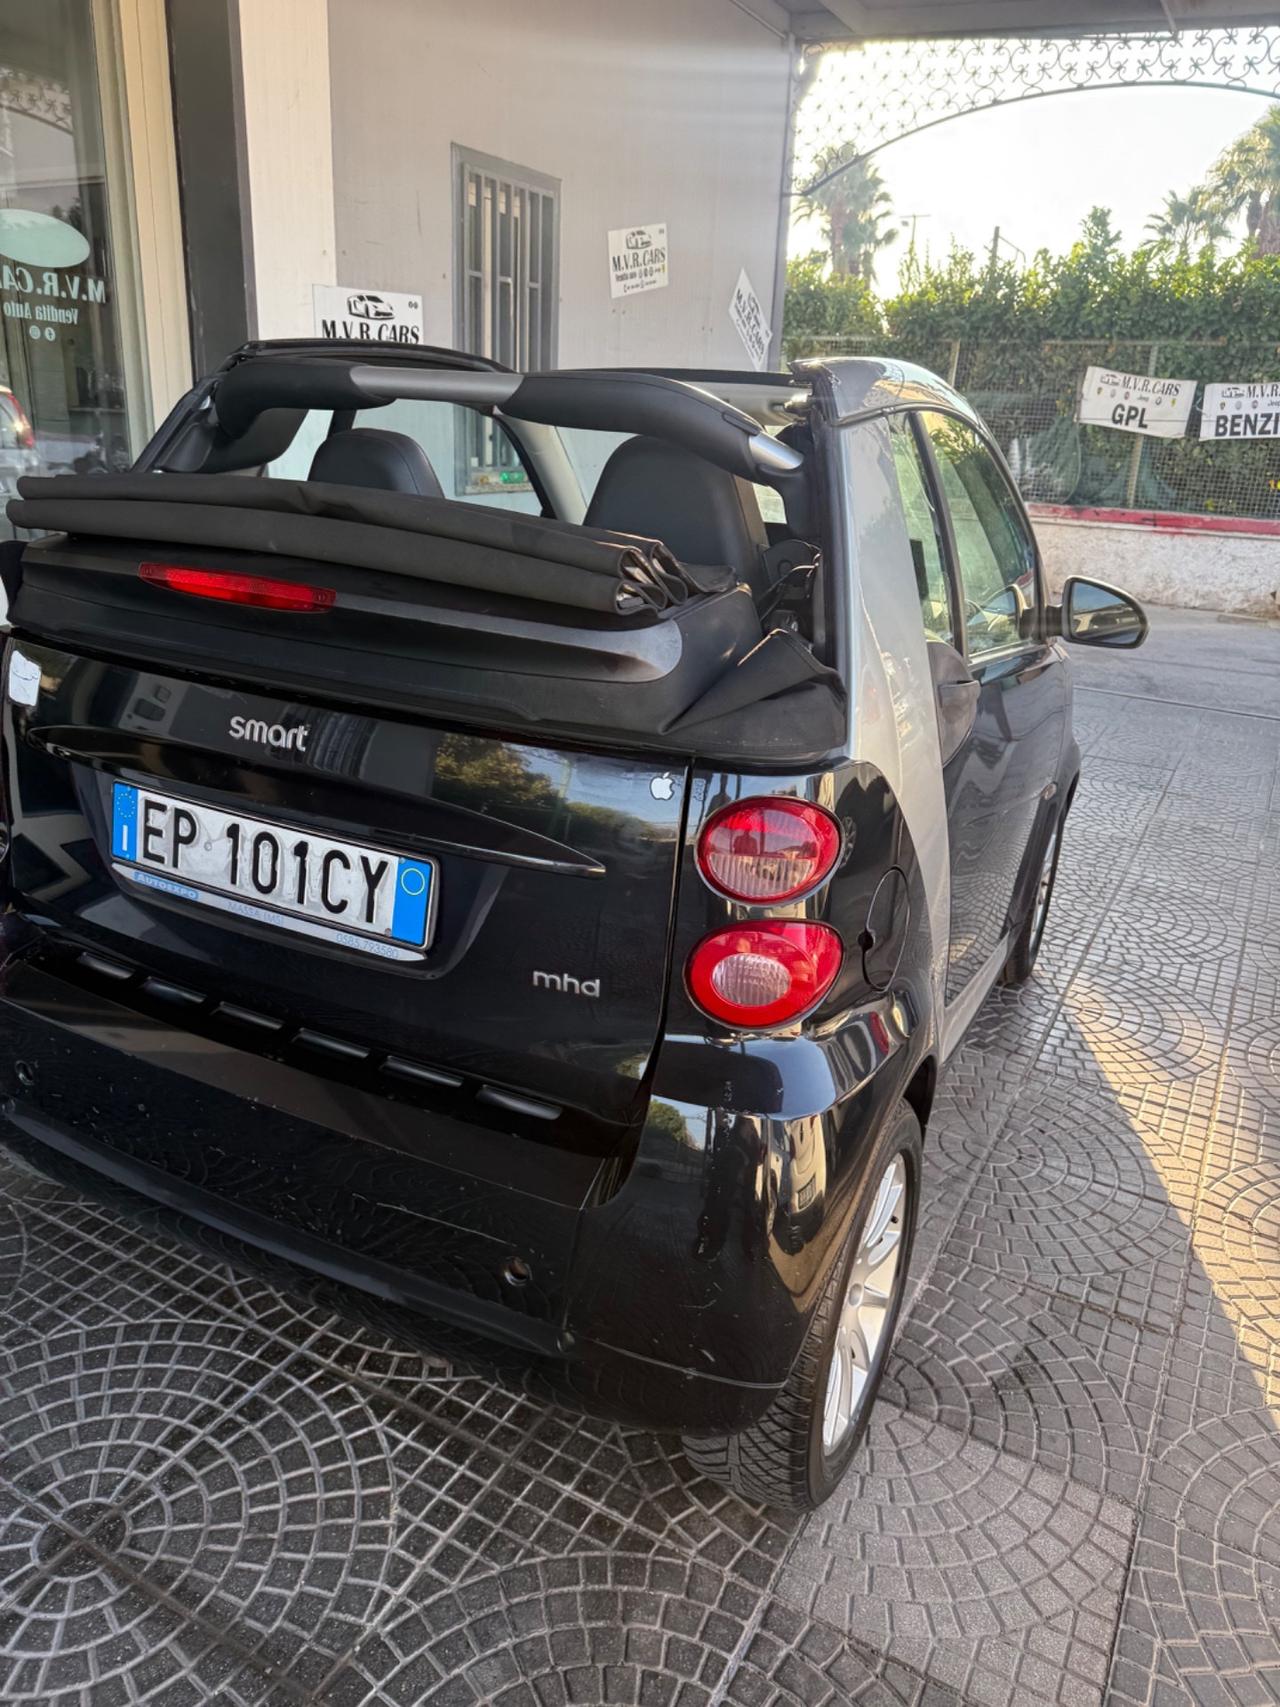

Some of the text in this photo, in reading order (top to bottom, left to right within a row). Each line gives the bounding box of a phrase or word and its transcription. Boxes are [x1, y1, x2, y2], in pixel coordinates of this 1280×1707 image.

[1111, 403, 1148, 429] GPL
[229, 716, 308, 752] smart
[143, 798, 197, 868] EP
[533, 970, 600, 998] mhd
